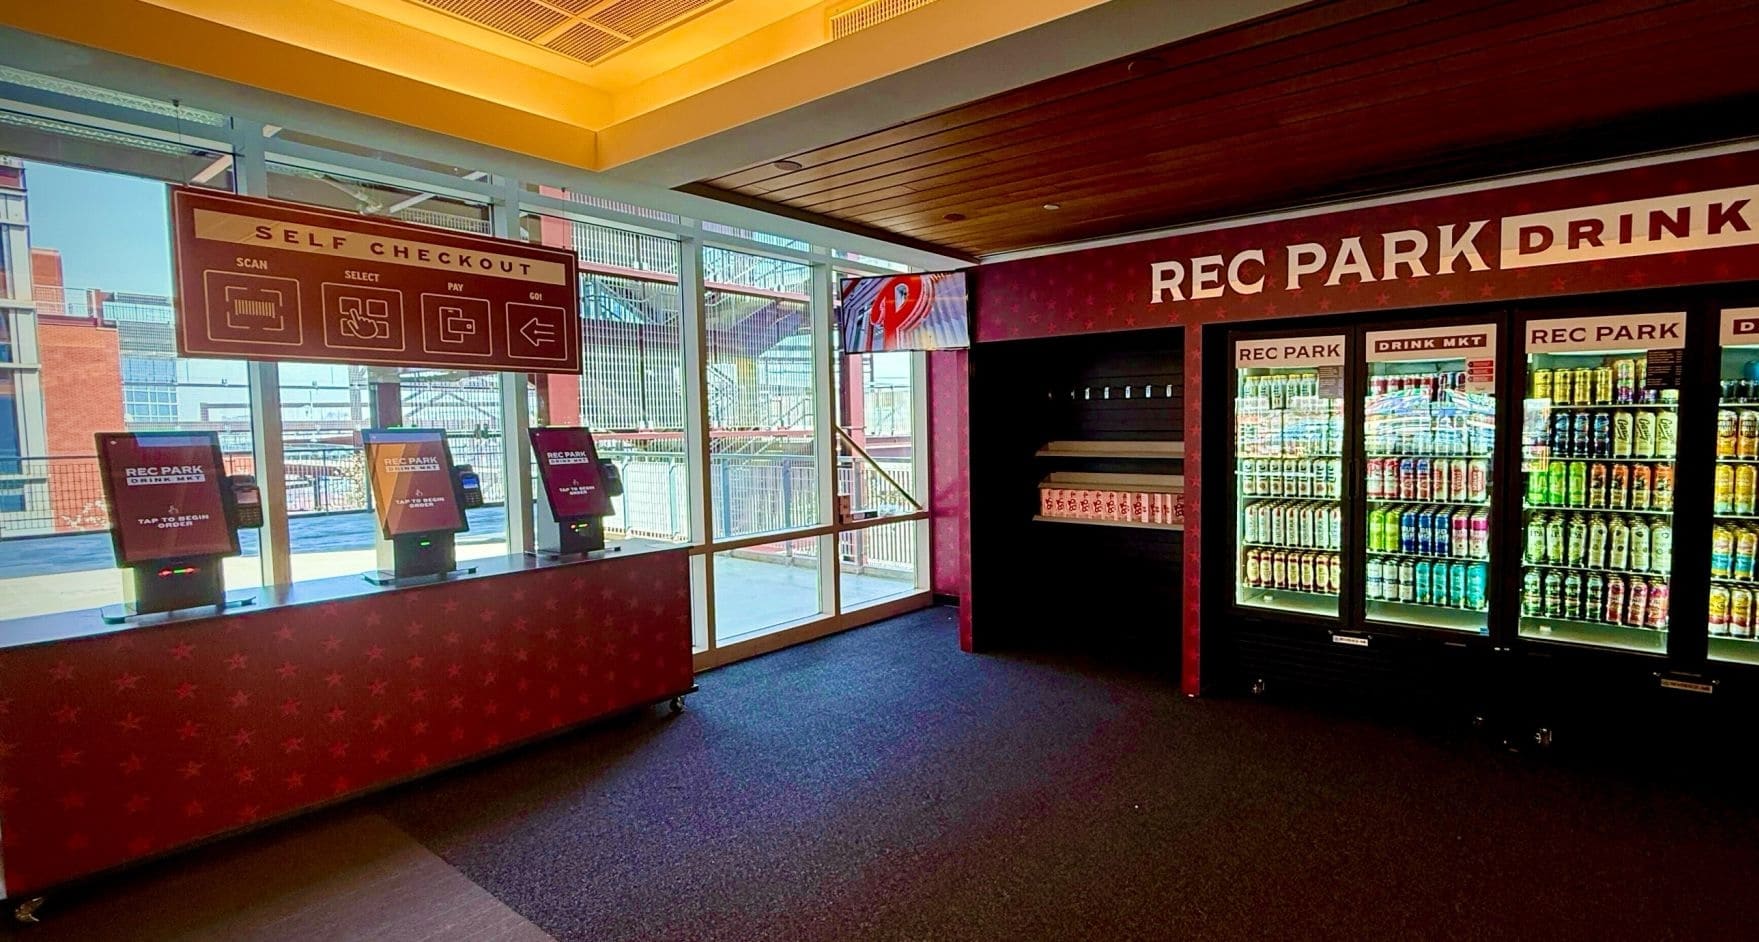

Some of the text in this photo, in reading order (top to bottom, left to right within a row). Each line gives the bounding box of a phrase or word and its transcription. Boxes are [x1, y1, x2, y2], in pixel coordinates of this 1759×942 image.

[255, 225, 531, 275] SELF CHECKOUT
[1150, 198, 1752, 305] REC PARK DRINK
[235, 257, 268, 270] SCAN
[344, 270, 380, 283] SELECT
[447, 282, 464, 293] PAY
[529, 291, 543, 301] GO!
[1531, 322, 1679, 345] REC PARK
[1378, 336, 1482, 351] DRINK MKT
[1239, 343, 1341, 361] REC PARK
[126, 466, 203, 476] REC PARK
